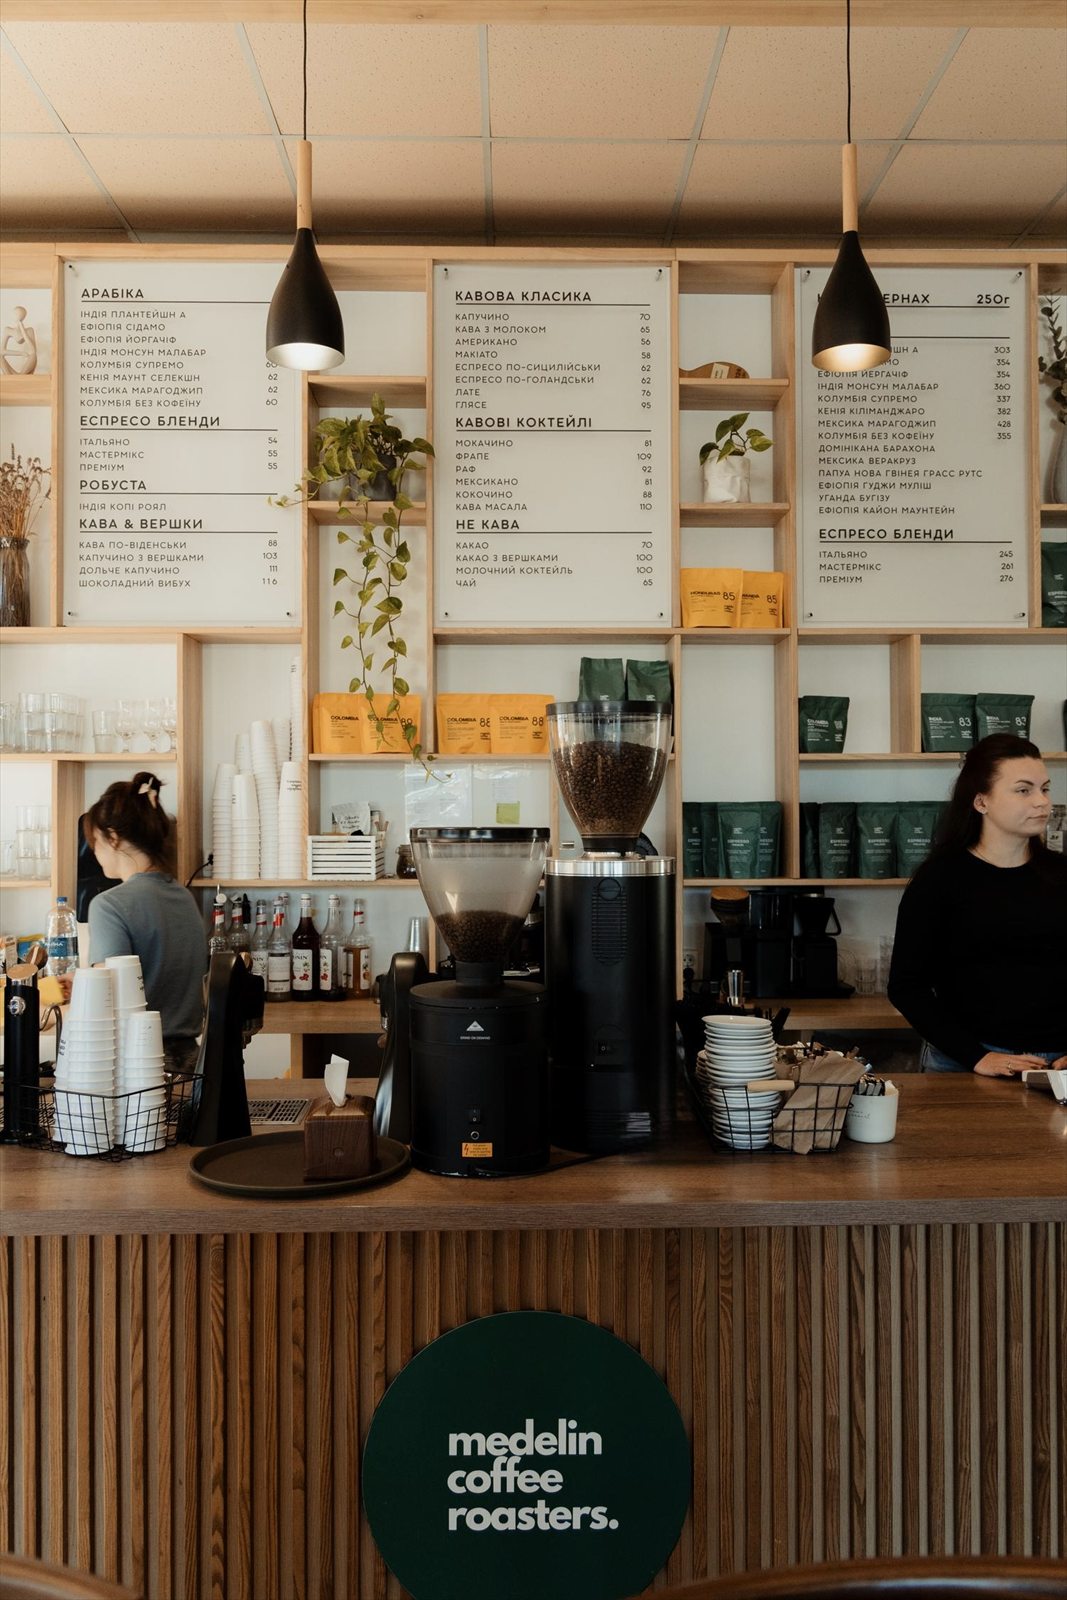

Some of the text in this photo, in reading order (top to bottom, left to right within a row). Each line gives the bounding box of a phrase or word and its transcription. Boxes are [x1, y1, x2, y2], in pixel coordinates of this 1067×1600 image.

[81, 288, 145, 299] АРАБІКА
[455, 290, 592, 302] КАВОВА КЛАСИКА
[883, 293, 930, 304] ЕРНАХ
[80, 309, 186, 319] ІНДІЯ ПЛАНТЕЙШН А
[455, 313, 510, 321] КАПУЧИНО
[80, 323, 166, 332] ЕФІОПІЯ СІДАМО
[455, 325, 481, 334] КАВА
[493, 325, 546, 334] МОЛОКОМ
[639, 326, 651, 334] 65
[80, 334, 177, 344] ЕФІОПІЯ ЙОРГАЧІФ
[455, 337, 651, 346] АМЕРИКАНО 56
[80, 348, 207, 357] ІНДІЯ МОНСУН МАЛАБАР
[455, 350, 498, 359] МАКІАТО
[994, 346, 1011, 354] 303
[80, 360, 184, 370] КОЛУМБІЯ СУПРЕМО
[455, 362, 651, 372] ЕСПРЕСО ПО-СИЦИЛІЙСЬКИ 62
[80, 373, 200, 382] КЕНІЯ МАУНТ СЕЛЕКШН
[996, 370, 1011, 379] 354
[455, 375, 651, 385] ЕСПРЕСО ПО-ГОЛАНДСЬКИ 62
[80, 386, 128, 395] МЕКСИКА
[131, 386, 203, 396] МАРАГОДЖИП
[817, 382, 1011, 391] ІНДІЯ МОНСУН МАЛАБАР 360
[455, 388, 480, 397] ЛАТЕ
[817, 394, 918, 403] КОЛУМБІЯ СУПРЕМО
[80, 399, 201, 408] КОЛУМБІЯ БЕЗ КОФЕЇНУ
[455, 401, 652, 410] ГЛЯСЕ 95
[817, 407, 1011, 416] КЕНІЯ КІЛІМАНДЖАРО 382
[80, 415, 220, 429] ЕСПРЕСО БЛЕНДИ
[455, 414, 592, 428] КАВОВІ КОКТЕЙЛІ
[817, 419, 936, 429] МЕКСИКА МАРАГОДЖИП
[818, 432, 1012, 440] КОЛУМБІЯ БЕЗ КОФЕЇНУ 355
[79, 438, 130, 446] ІТАЛЬЯНО
[455, 439, 514, 448] МОКАЧИНО
[818, 444, 936, 453] ДОМІНІКАНА БАРАХОНА
[79, 451, 145, 459] МАСТЕРМІКС
[455, 452, 652, 461] ФРАПЕ 109
[818, 456, 916, 465] МЕКСИКА ВЕРАКРУЗ
[79, 463, 125, 472] ПРЕМІУМ
[455, 465, 652, 473] РАФ 92
[818, 469, 983, 478] ПАПУА НОВА ГВІНЕЯ ГРАСС РУТС
[79, 479, 147, 491] РОБУСТА
[455, 477, 519, 486] МЕКСИКАНО
[818, 481, 932, 490] ЕФІОПІЯ МУЛІШ
[455, 490, 653, 499] КОКОЧИНО 88
[818, 494, 890, 503] УГАНДА БУГІЗУ
[79, 503, 167, 512] ІНДІЯ КОПІ РОЯЛ
[455, 502, 653, 511] КАВА МАСАЛА 110
[818, 505, 955, 515] ЕФІОПІЯ КАЙОН МАУНТЕЙН
[79, 518, 203, 530] КАВА & ВЕРШКИ
[456, 519, 520, 530] НЕ КАВА
[819, 528, 954, 541] ЕСПРЕСО БЛЕНДИ
[79, 539, 278, 550] КАВА ПО-ВІДЕНСЬКИ 88
[455, 541, 489, 550] КАКАО
[79, 554, 134, 562] КАПУЧИНО
[147, 554, 204, 562] ВЕРШКАМИ
[263, 552, 278, 560] 103
[455, 554, 489, 562] КАКАО
[501, 554, 558, 562] ВЕРШКАМИ
[636, 553, 653, 562] 100
[819, 550, 1014, 559] ІТАЛЬЯНО 245
[79, 566, 180, 575] ДОЛЬЧЕ КАПУЧИНО
[456, 565, 573, 575] МОЛОЧНИЙ КОКТЕЙЛЬ
[819, 563, 881, 571] МАСТЕРМІКС
[79, 578, 154, 588] ШОКОЛАДНИЙ
[158, 579, 191, 588] ВИБУХ
[455, 577, 654, 587] ЧАЙ 65
[819, 574, 1014, 584] ПРЕМІУМ 276
[723, 592, 735, 600] 85
[767, 595, 777, 604] 85
[532, 717, 544, 727] 88
[959, 717, 971, 727] 83
[448, 1418, 602, 1456] medelin
[447, 1456, 563, 1493] coffee
[448, 1499, 619, 1530] roasters.
